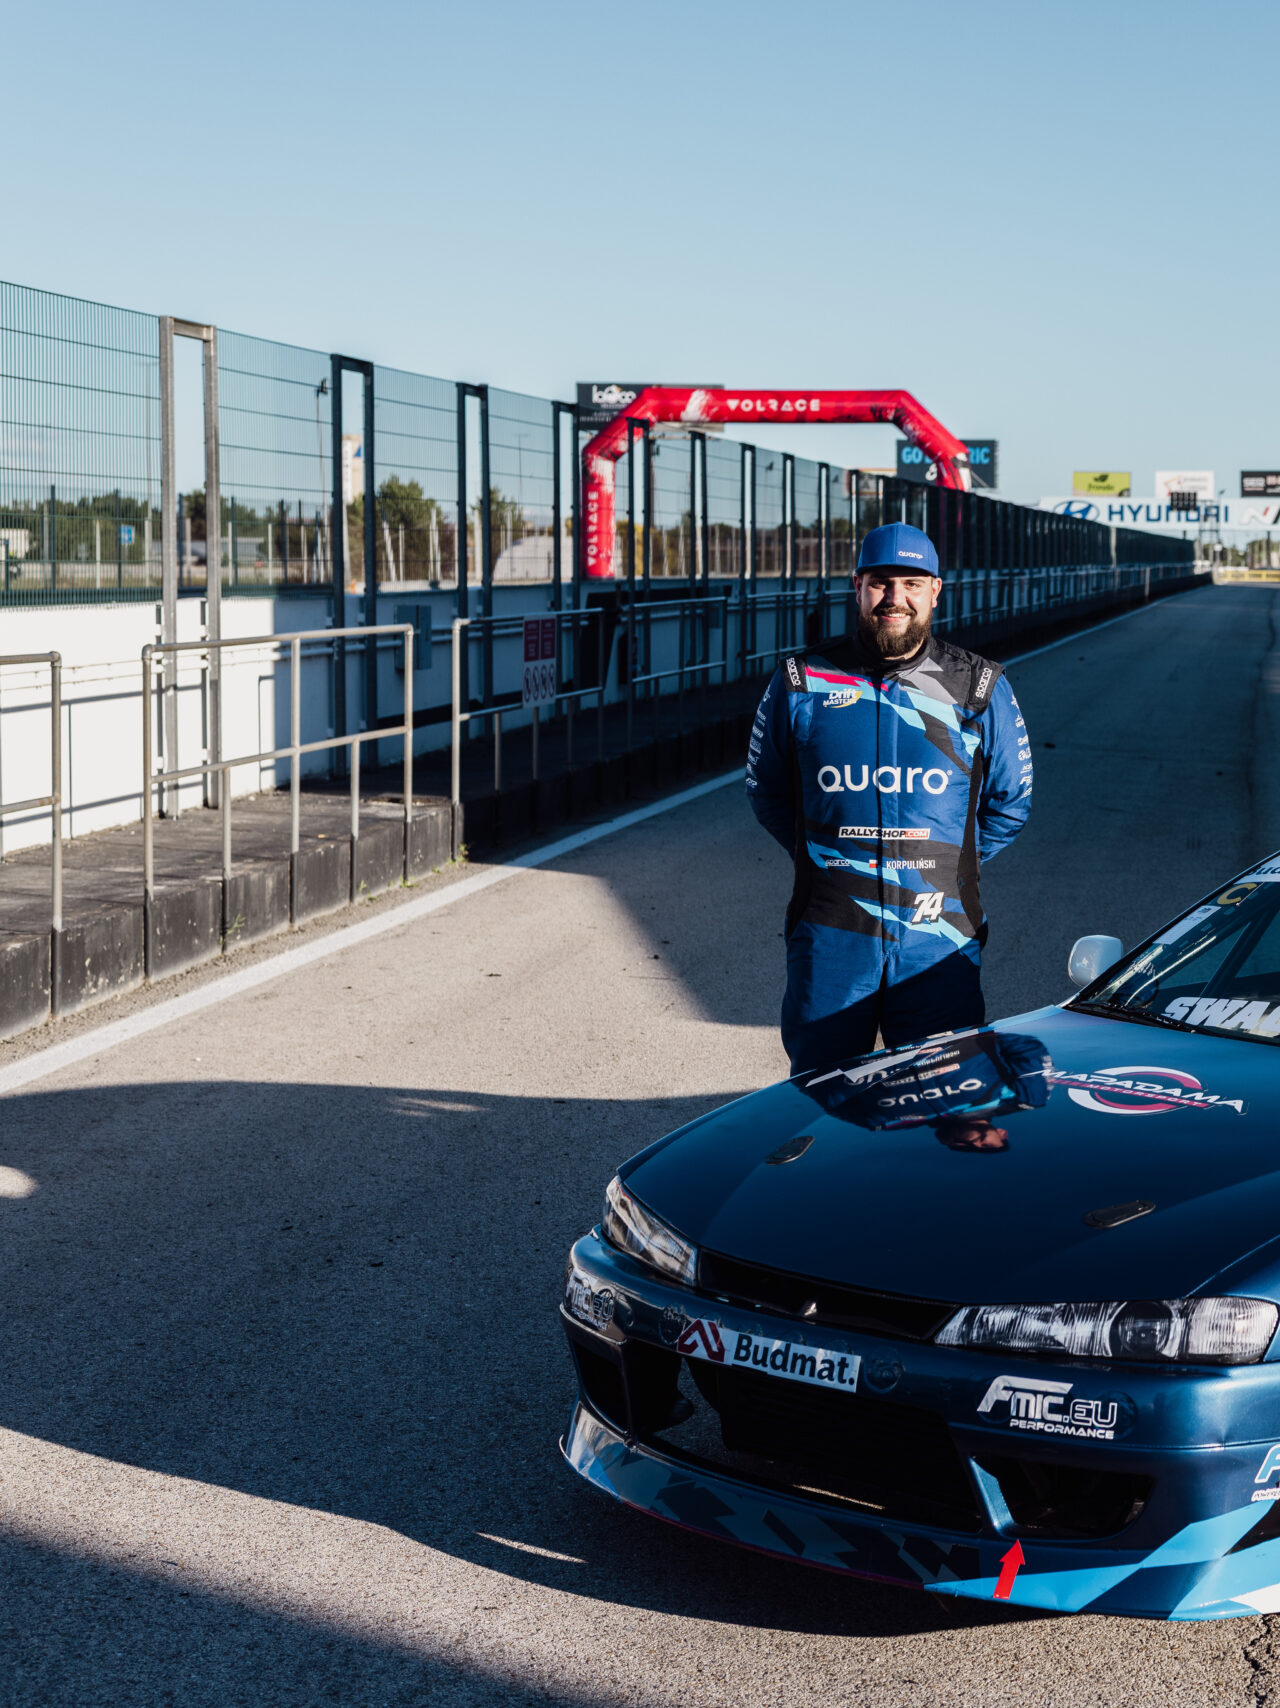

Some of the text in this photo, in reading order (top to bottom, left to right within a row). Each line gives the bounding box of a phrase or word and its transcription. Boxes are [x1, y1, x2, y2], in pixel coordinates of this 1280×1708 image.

[901, 446, 923, 464] GO
[1107, 505, 1229, 523] HYUNDAI
[787, 657, 802, 687] sparco
[975, 667, 993, 699] sparco
[828, 688, 857, 700] Drift
[912, 892, 944, 923] 74
[1087, 1083, 1202, 1107] MOTORSPORT
[1010, 1419, 1115, 1440] PERFORMANCE
